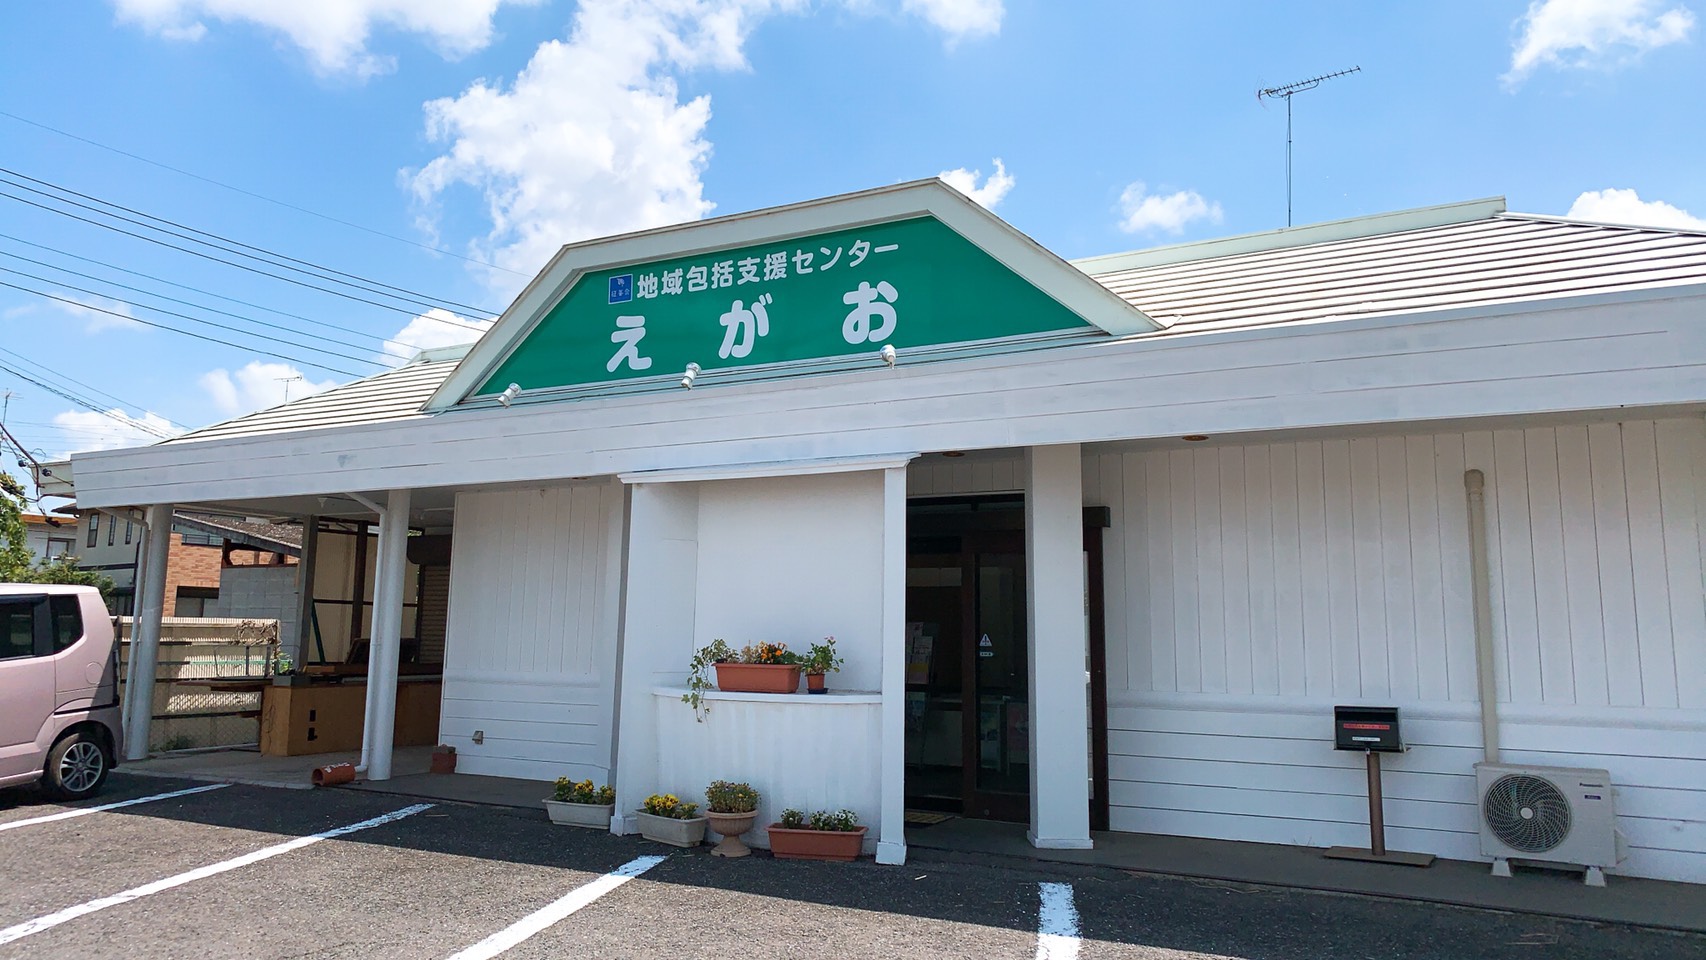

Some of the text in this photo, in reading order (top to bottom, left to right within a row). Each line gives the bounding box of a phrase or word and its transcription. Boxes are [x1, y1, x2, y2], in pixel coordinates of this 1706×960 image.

[636, 240, 899, 299] 地域包括支援センター
[606, 280, 899, 373] えがお
